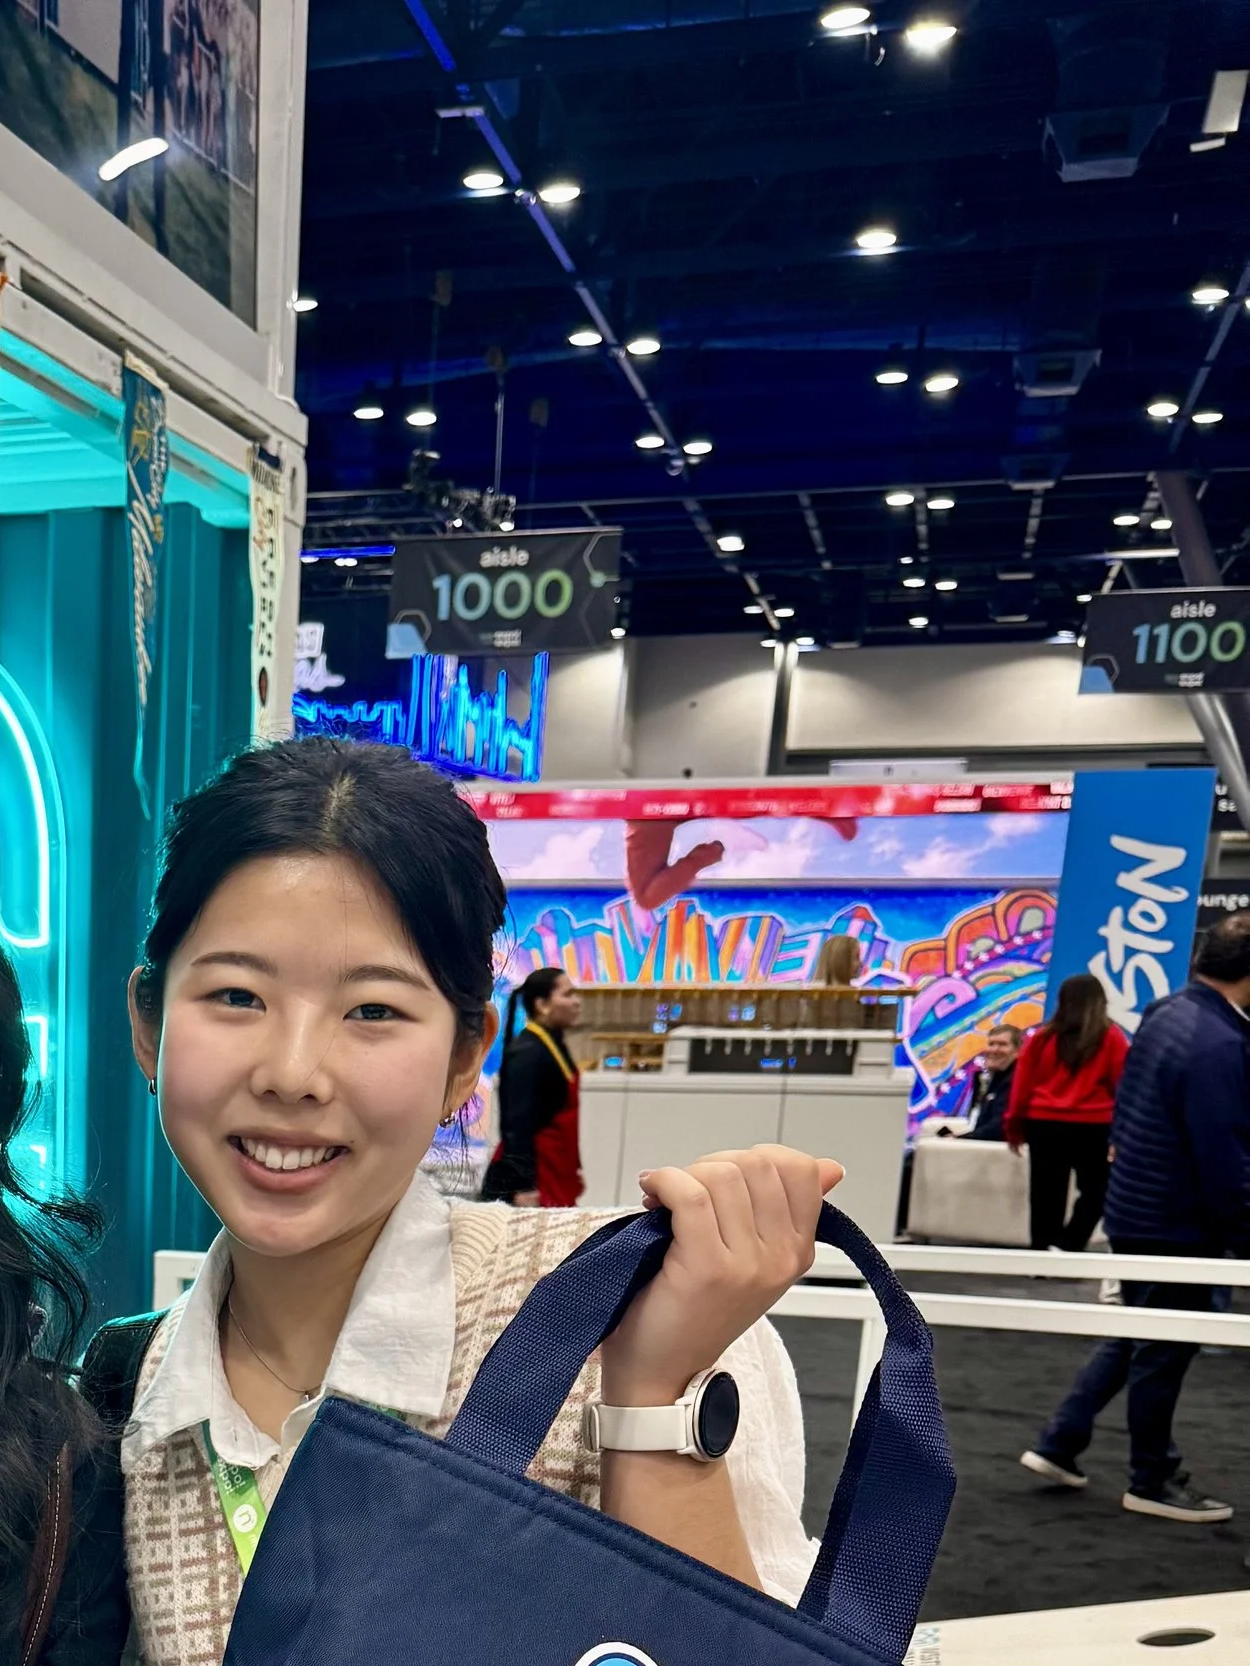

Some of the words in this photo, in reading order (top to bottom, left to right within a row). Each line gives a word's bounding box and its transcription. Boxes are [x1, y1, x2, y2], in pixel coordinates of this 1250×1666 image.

[479, 545, 530, 568] aisle
[432, 568, 574, 622] 1000
[1170, 600, 1217, 619] aisle
[1132, 620, 1247, 664] 1100
